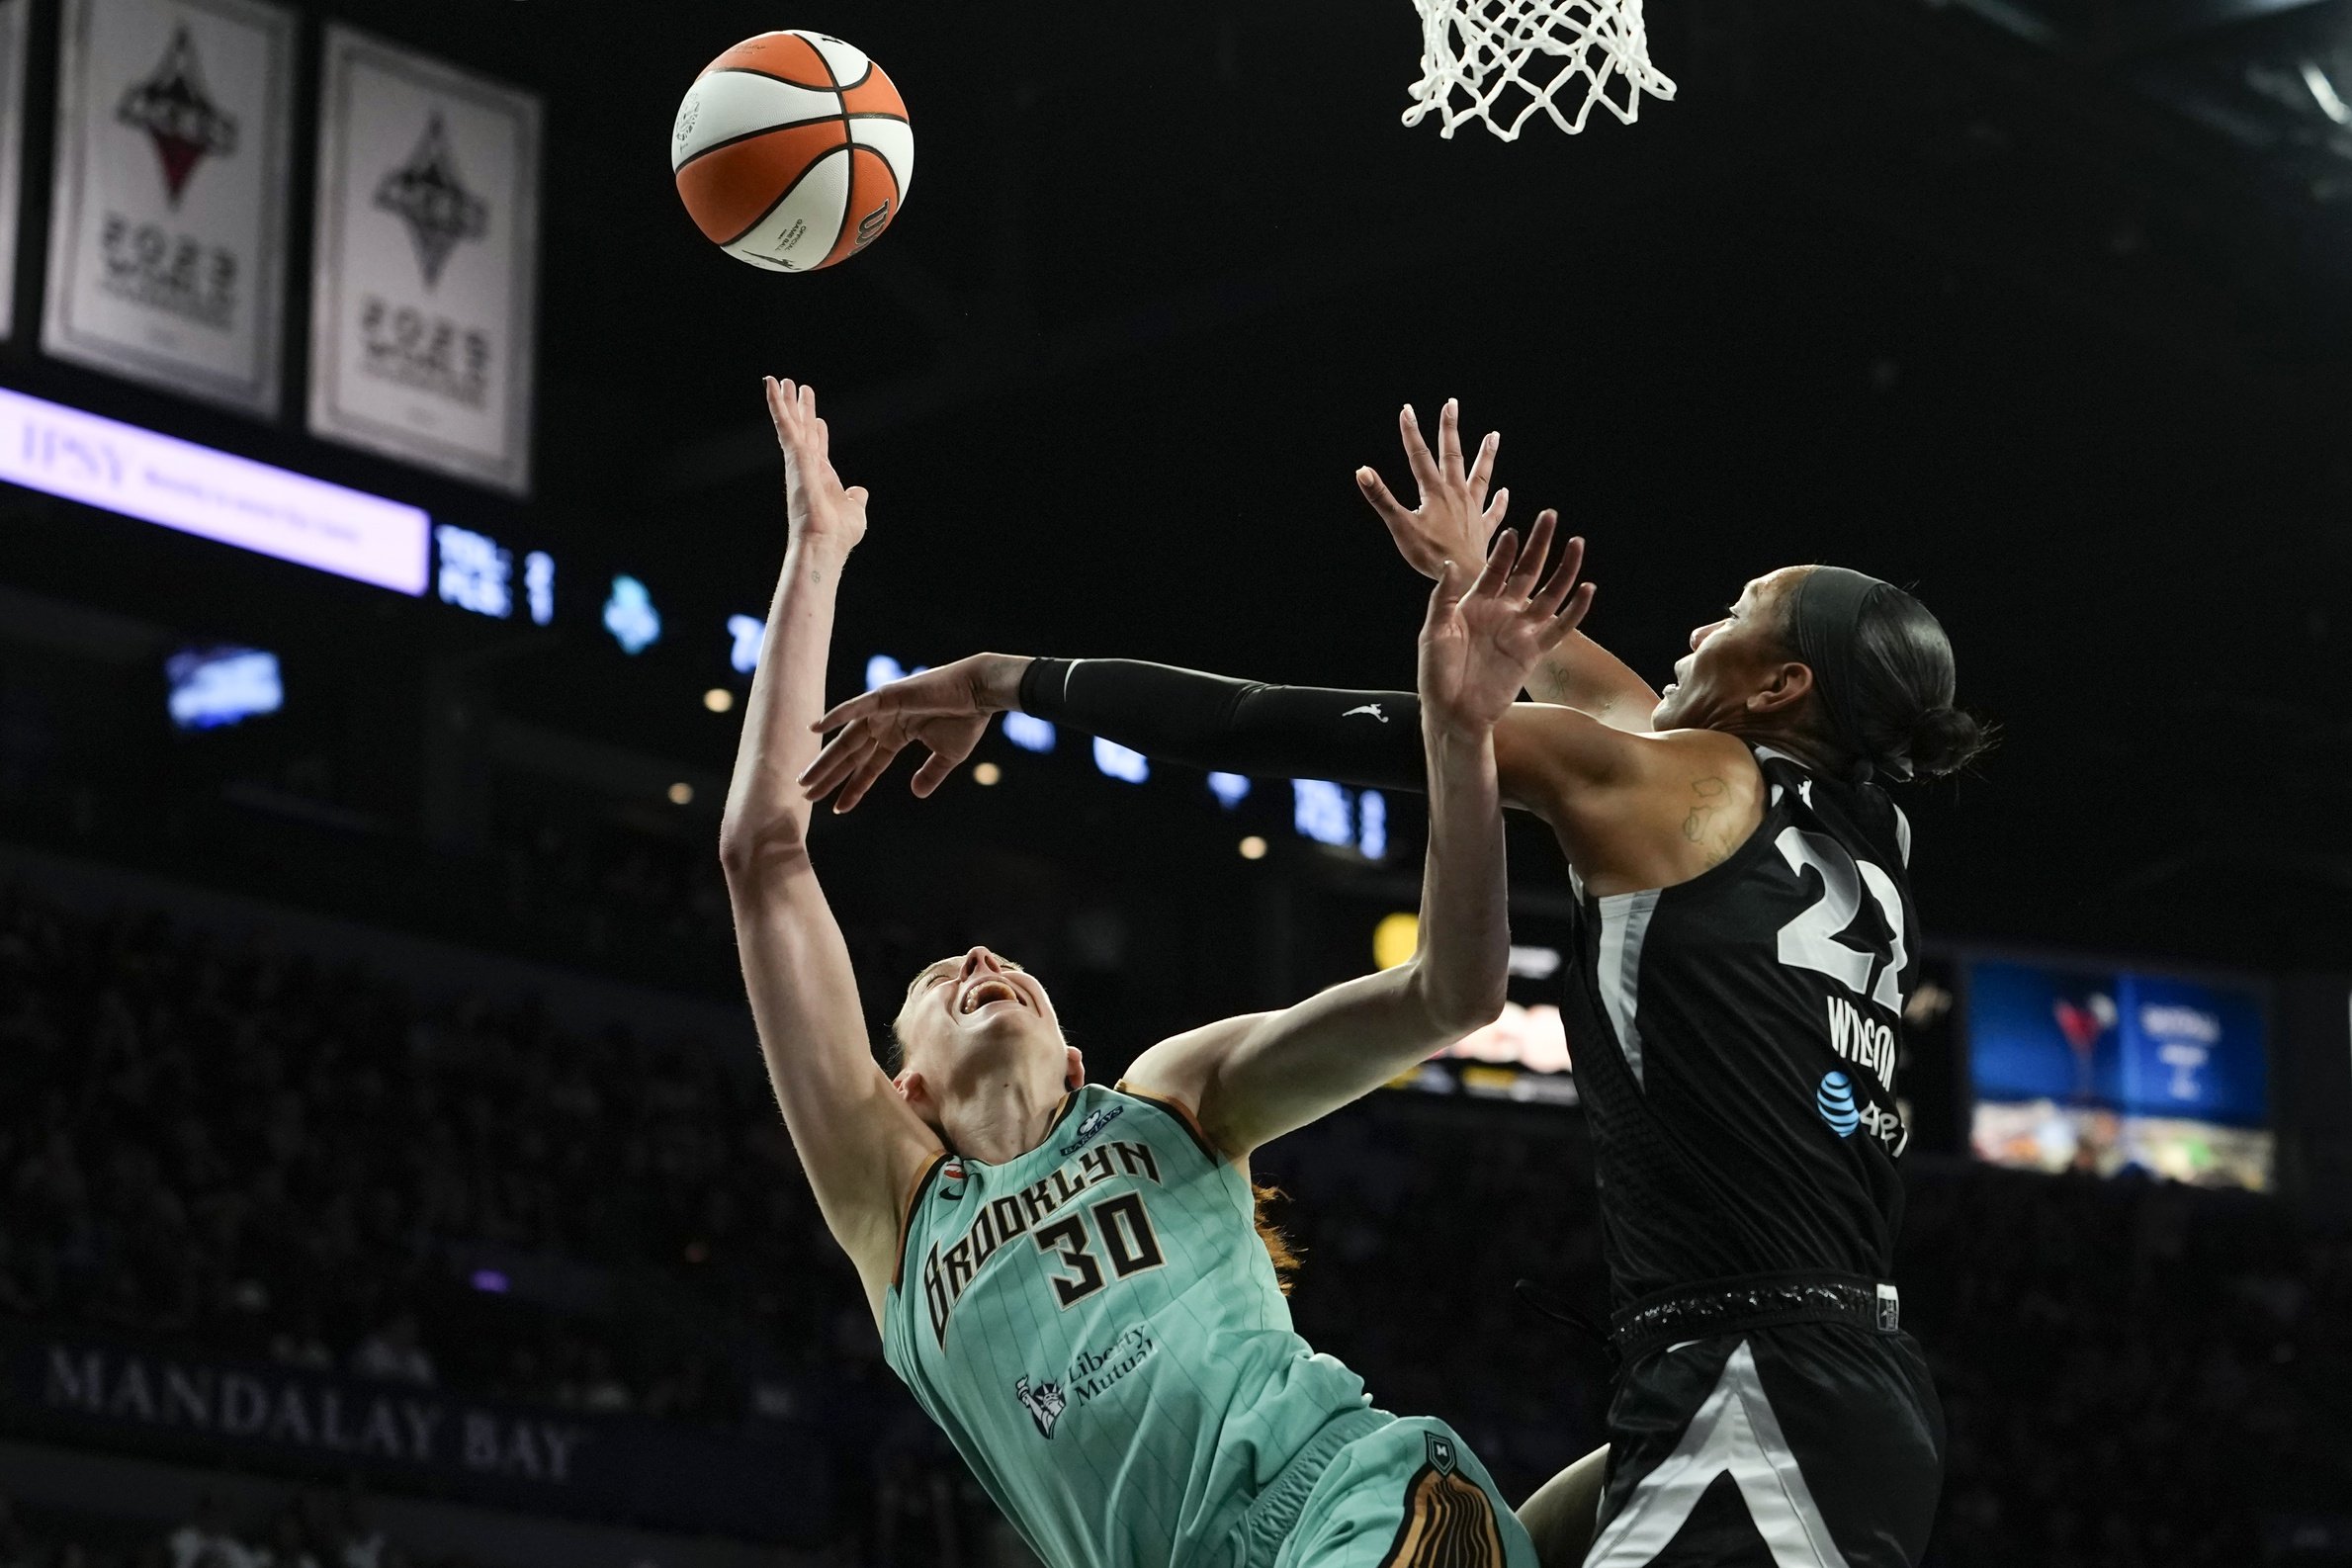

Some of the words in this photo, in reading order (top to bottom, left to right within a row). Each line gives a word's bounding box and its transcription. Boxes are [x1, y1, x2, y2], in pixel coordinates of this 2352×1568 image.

[1775, 827, 1908, 1017] 22
[1064, 1107, 1121, 1155] BARCLAYS
[1860, 1099, 1908, 1158] A&T
[924, 1141, 1163, 1358] BROOKLYN
[1033, 1190, 1166, 1311] 30
[1068, 1325, 1146, 1383] Liberty
[1075, 1338, 1158, 1407] Mutual
[45, 1345, 442, 1461] MANDALAY
[463, 1411, 586, 1479] BAY
